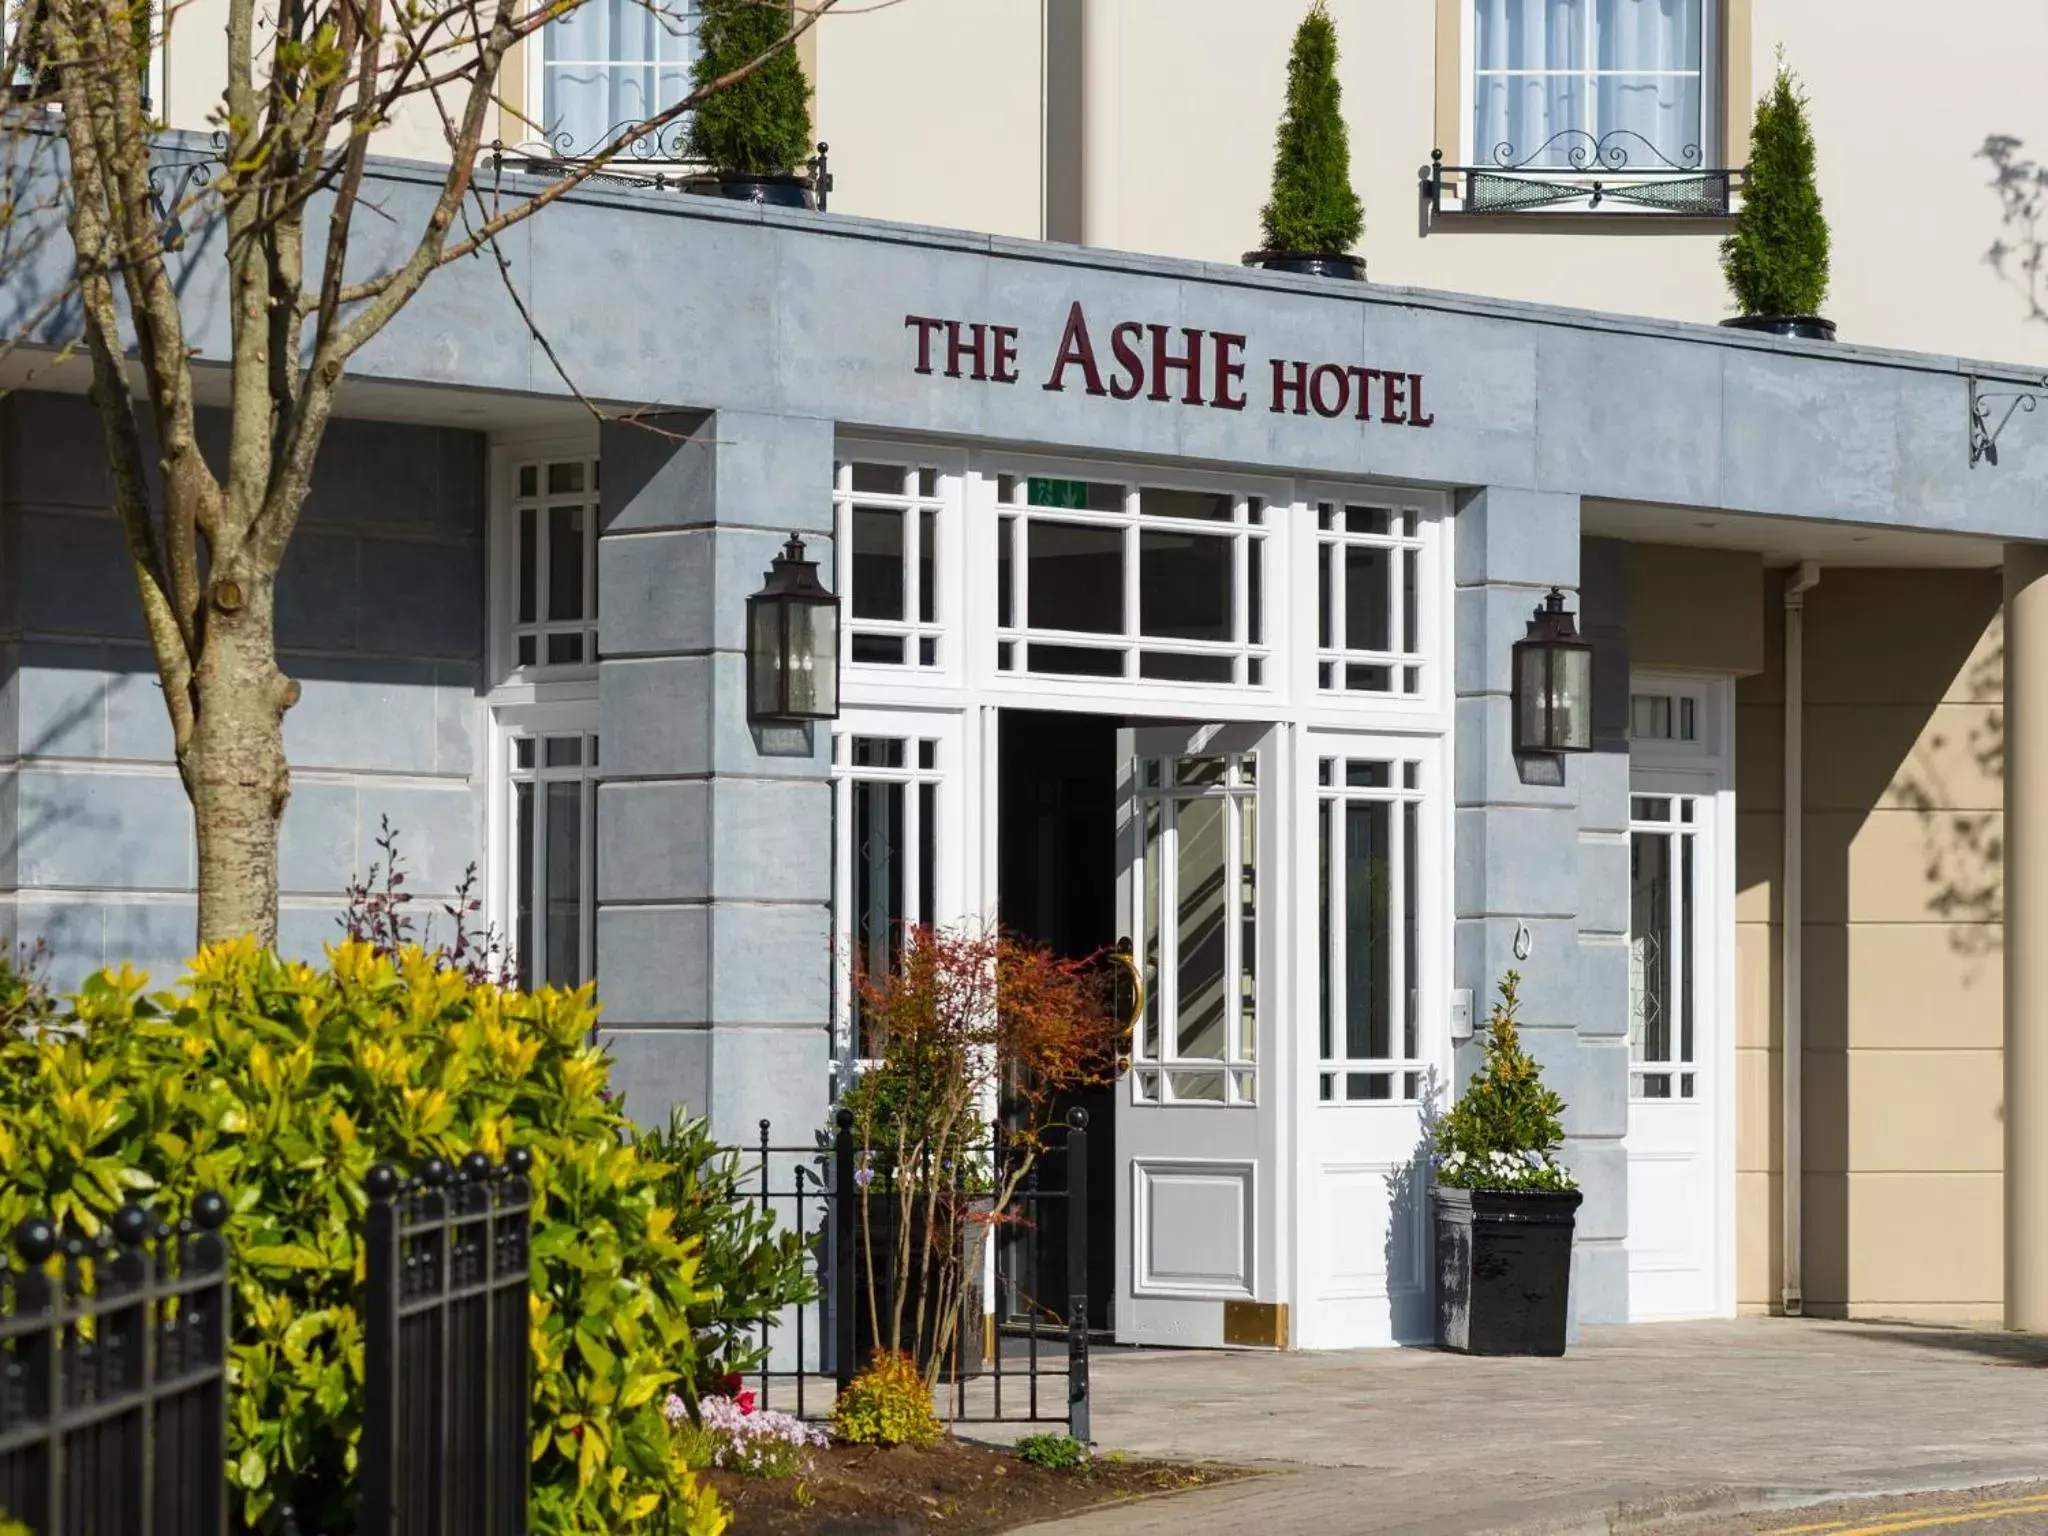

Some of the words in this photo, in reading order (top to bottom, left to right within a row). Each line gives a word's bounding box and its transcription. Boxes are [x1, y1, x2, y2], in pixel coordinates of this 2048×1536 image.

[905, 314, 1018, 384] THE
[1042, 300, 1247, 411] ASHE
[1270, 358, 1434, 428] HOTEL
